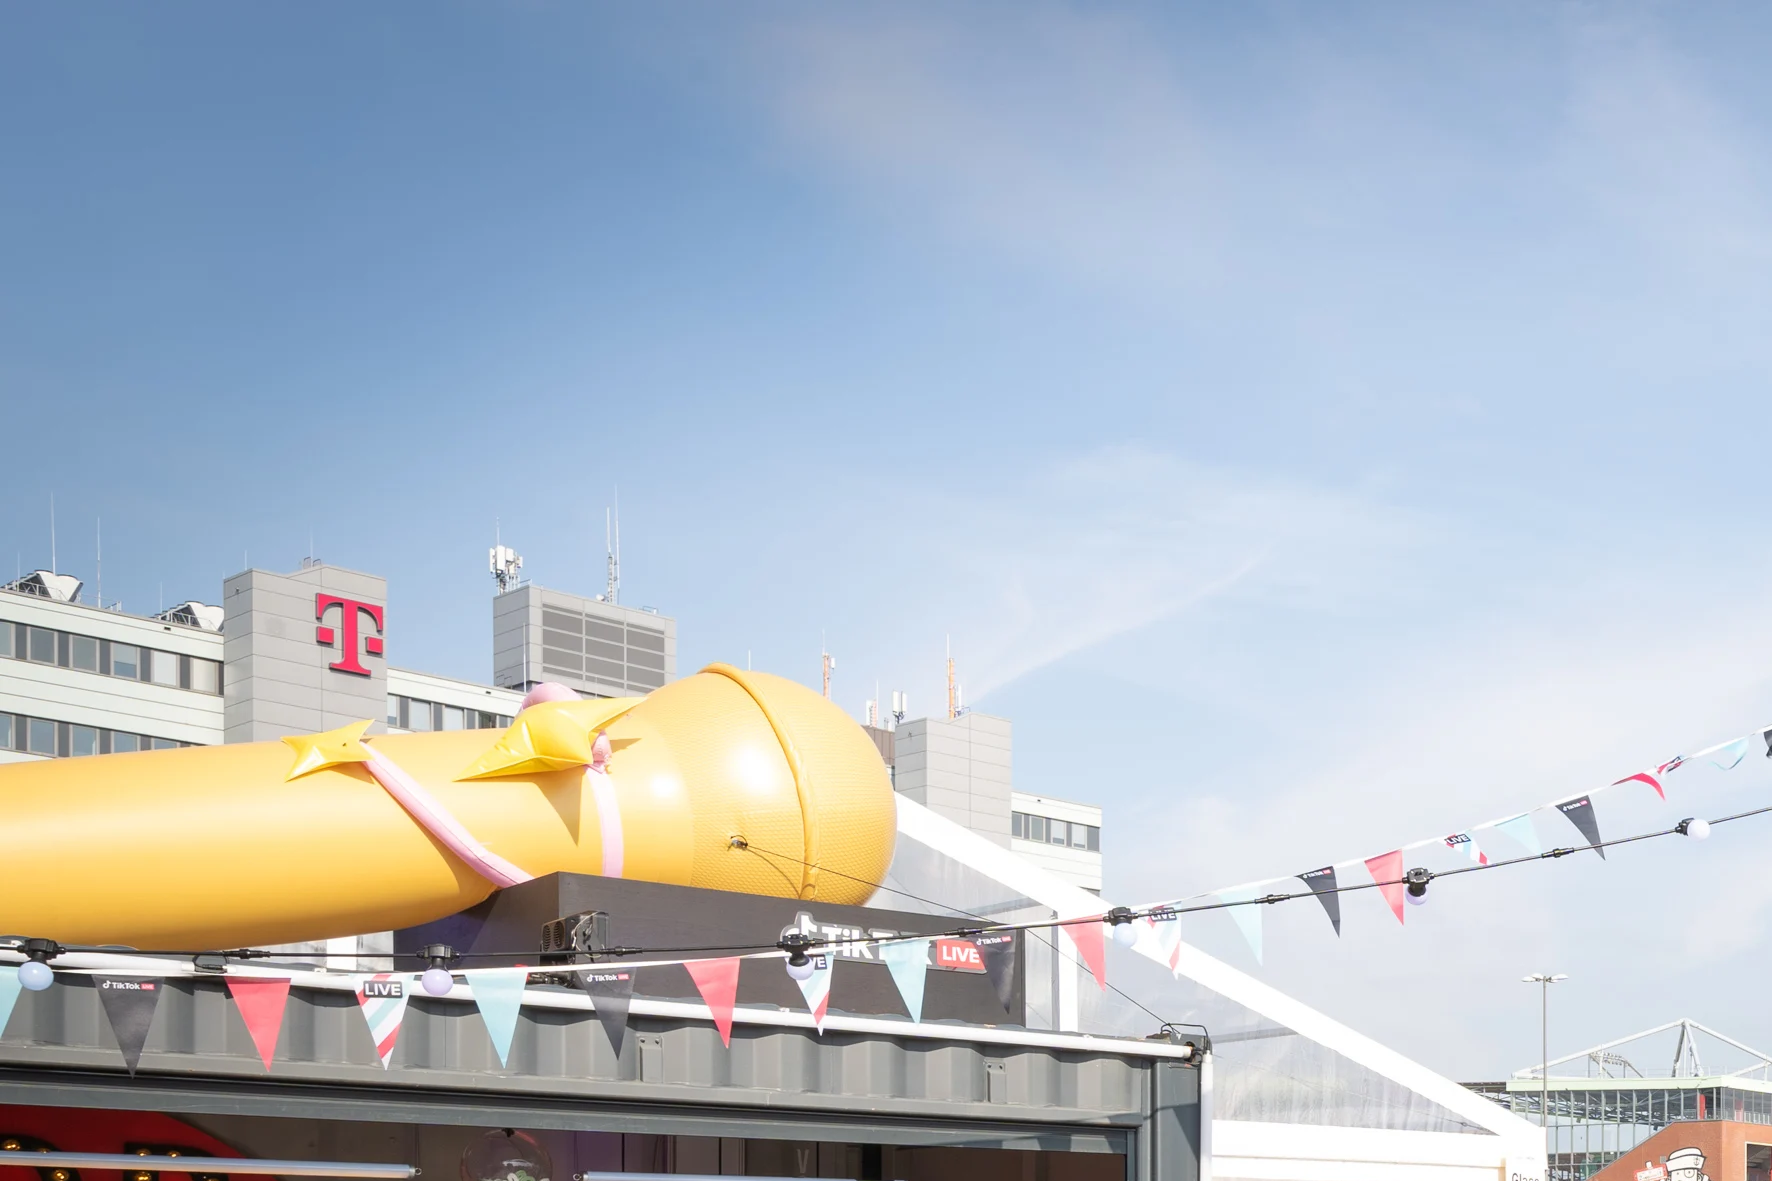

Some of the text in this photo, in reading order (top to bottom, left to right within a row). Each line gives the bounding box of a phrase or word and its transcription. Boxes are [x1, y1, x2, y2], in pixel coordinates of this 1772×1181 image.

[315, 593, 383, 676] T
[1447, 834, 1470, 845] LIVE
[942, 946, 980, 963] LIVE
[112, 980, 141, 990] TikTok
[365, 983, 401, 996] LIVE
